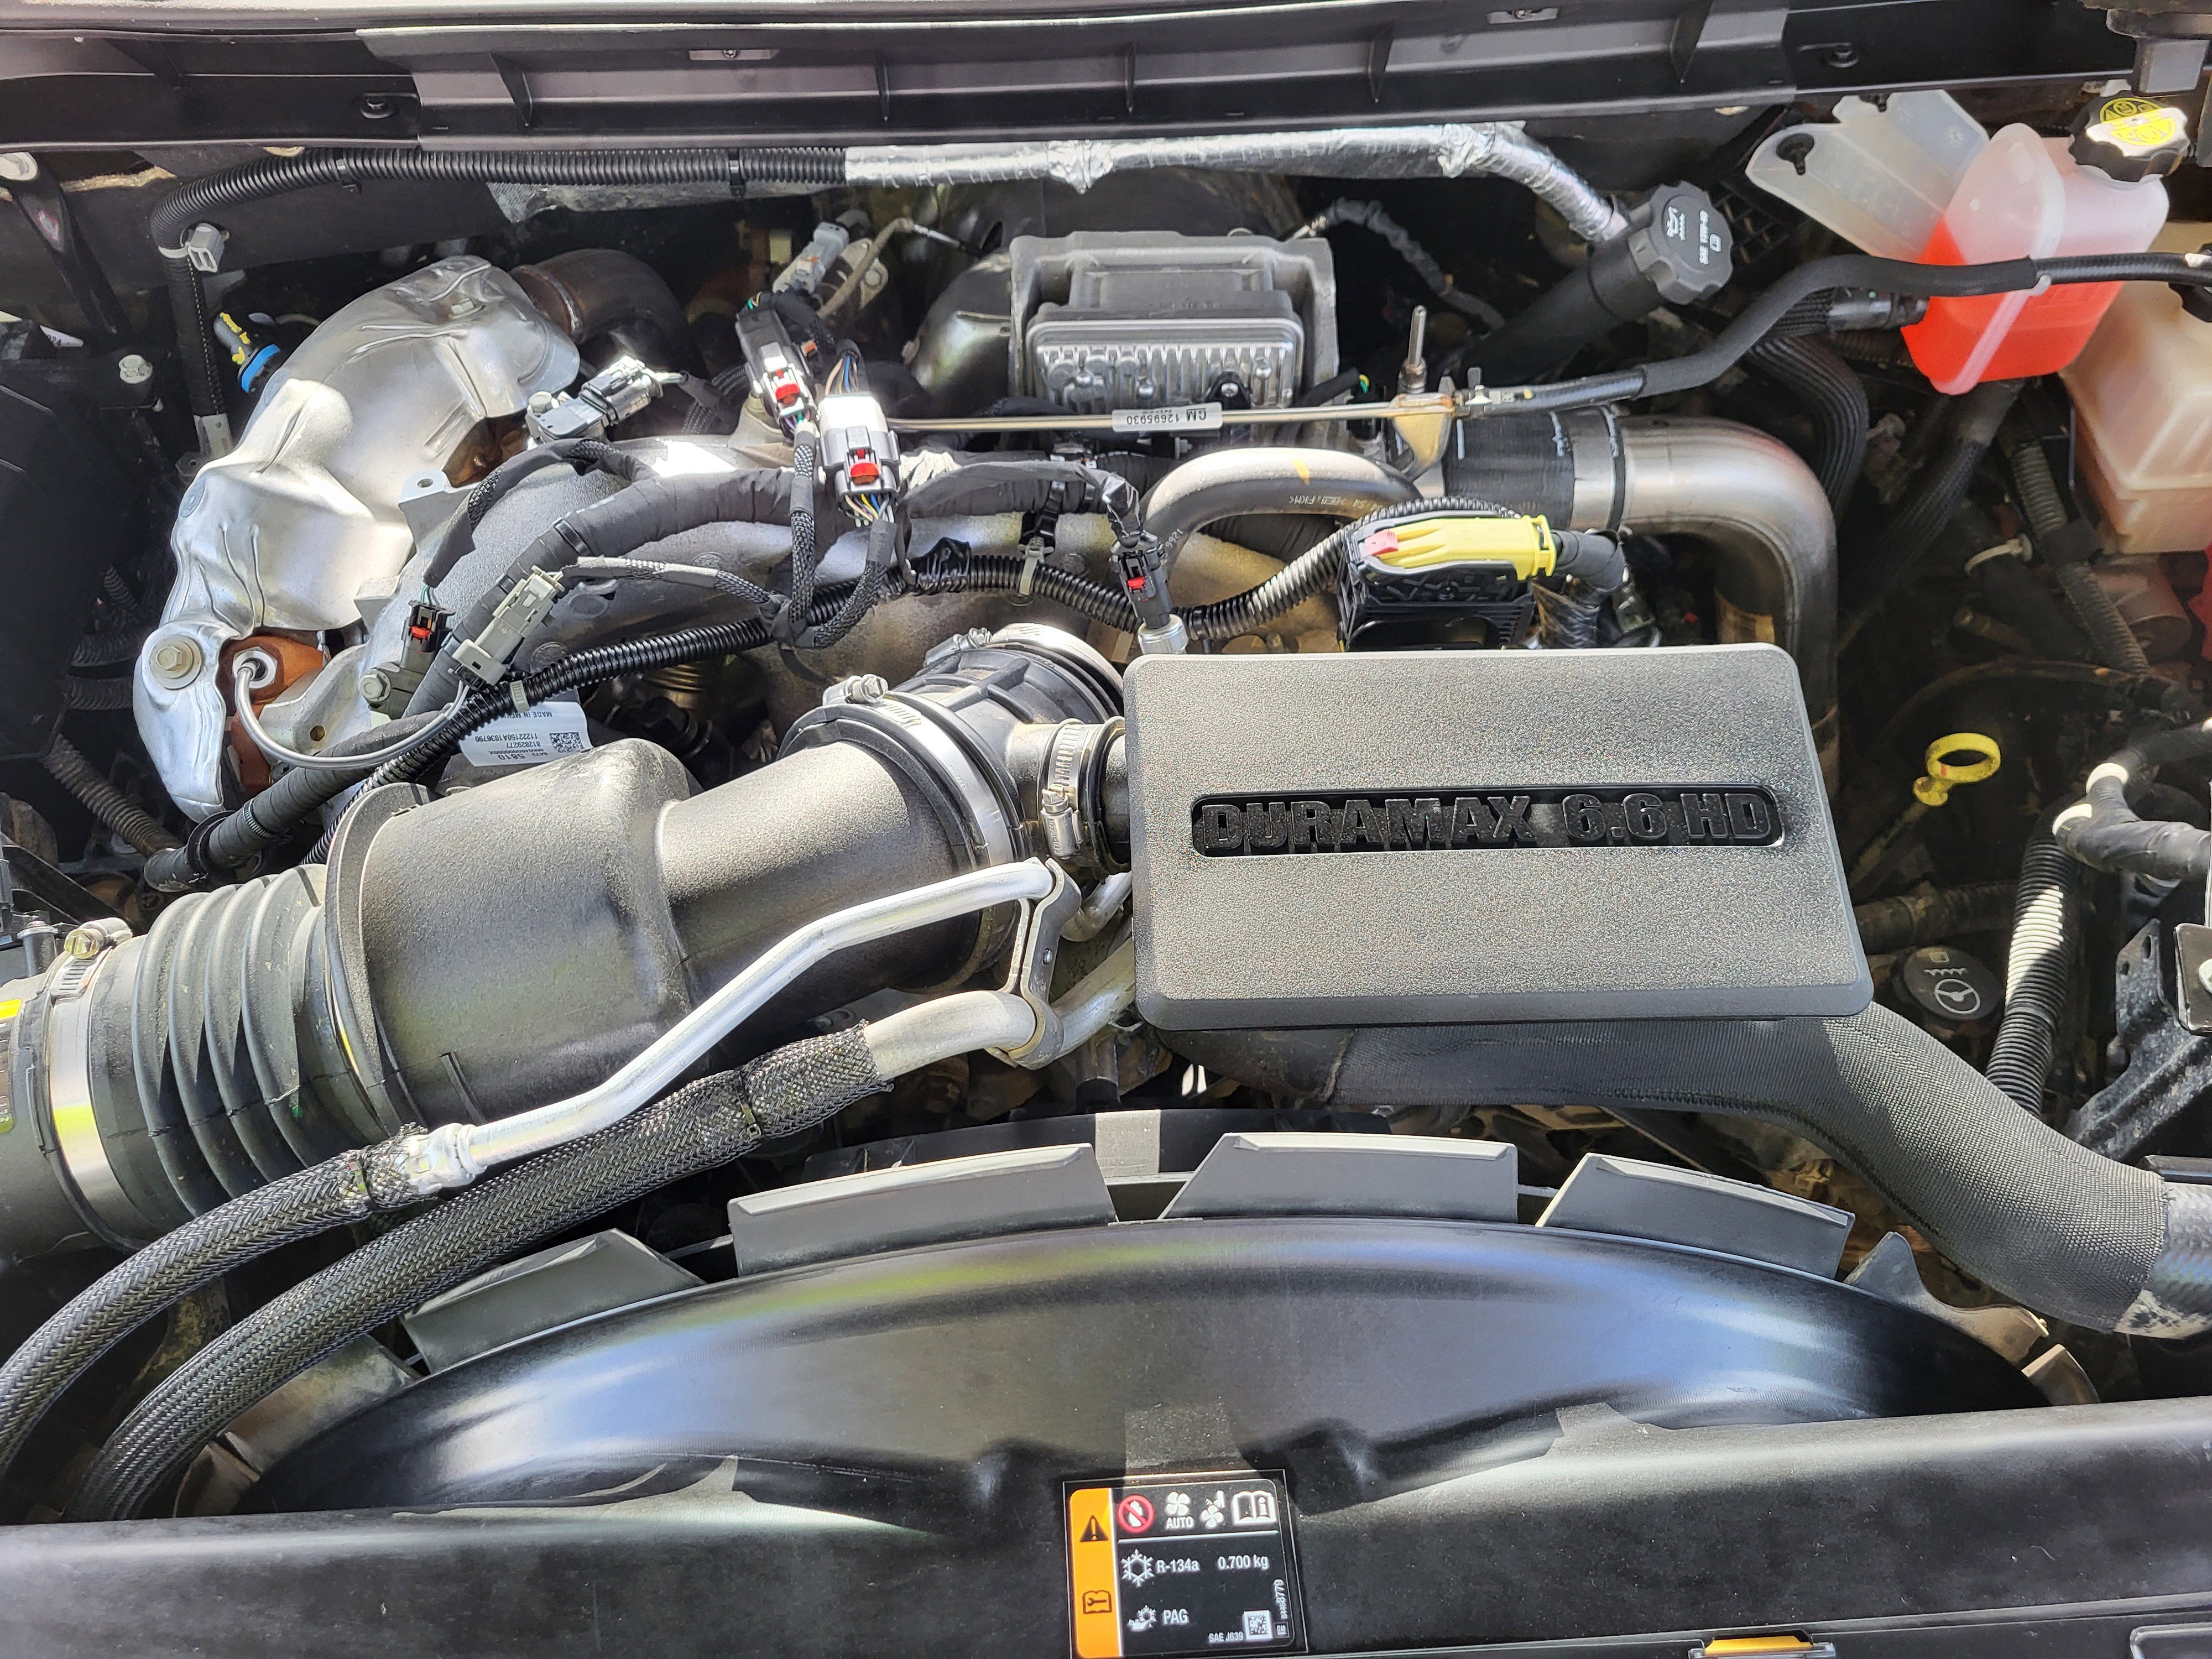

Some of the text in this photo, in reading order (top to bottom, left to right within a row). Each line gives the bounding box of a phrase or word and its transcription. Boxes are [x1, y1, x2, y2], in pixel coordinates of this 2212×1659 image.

[1126, 409, 1207, 425] GM 12695930
[1201, 792, 1772, 851] DURAMAX 6.6 HD
[1166, 1516, 1194, 1530] AUTO
[1156, 1558, 1201, 1574] R-134a
[1218, 1554, 1269, 1571] 0.700 kg
[1163, 1608, 1189, 1624] PAG
[1209, 1631, 1244, 1642] SAE J639
